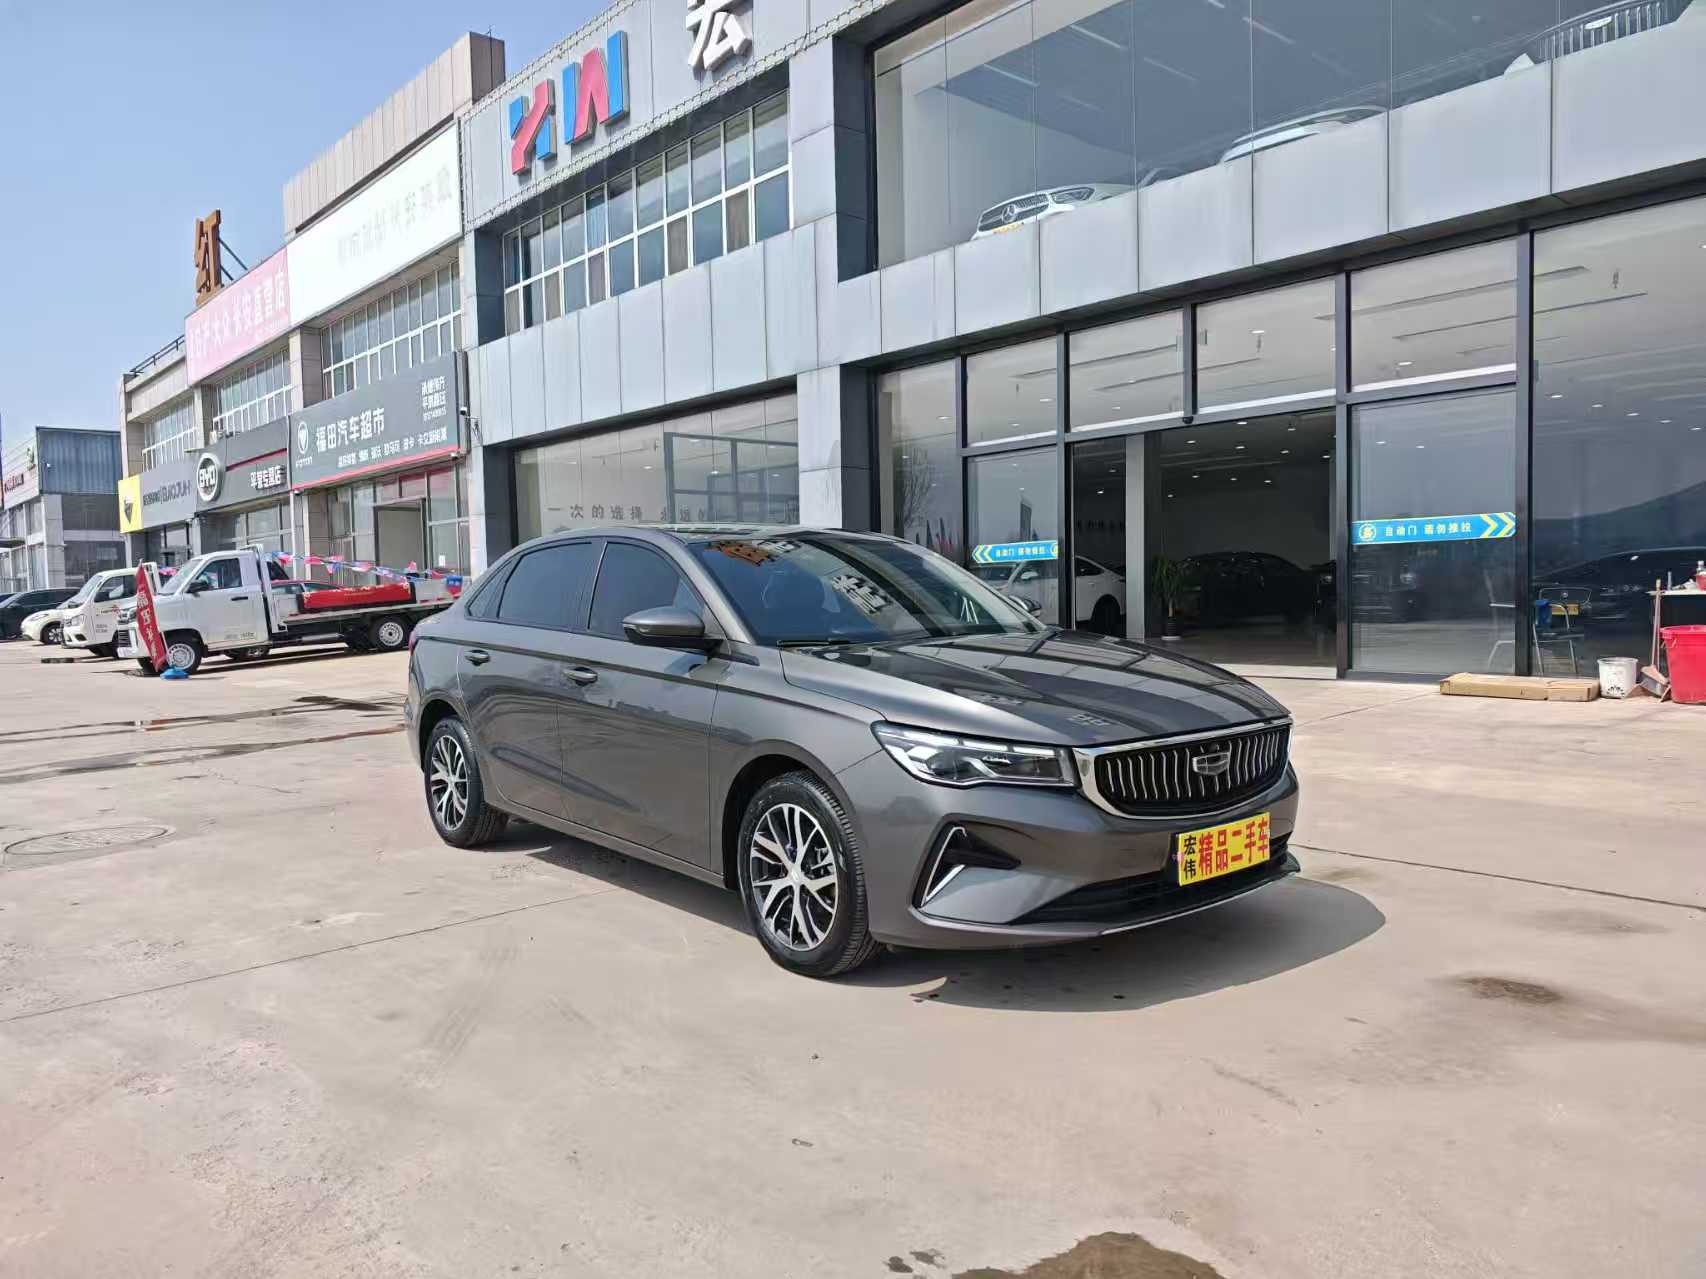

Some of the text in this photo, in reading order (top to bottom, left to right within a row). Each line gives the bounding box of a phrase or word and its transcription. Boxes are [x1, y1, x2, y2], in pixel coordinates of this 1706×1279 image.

[316, 408, 384, 452] 福田汽车超市
[199, 465, 217, 488] BYD
[547, 504, 642, 521] 一次的选择
[1385, 522, 1472, 537] 自动门 请勿推拉
[1184, 835, 1196, 880] 宏伟
[1199, 817, 1269, 876] 精品二手车
